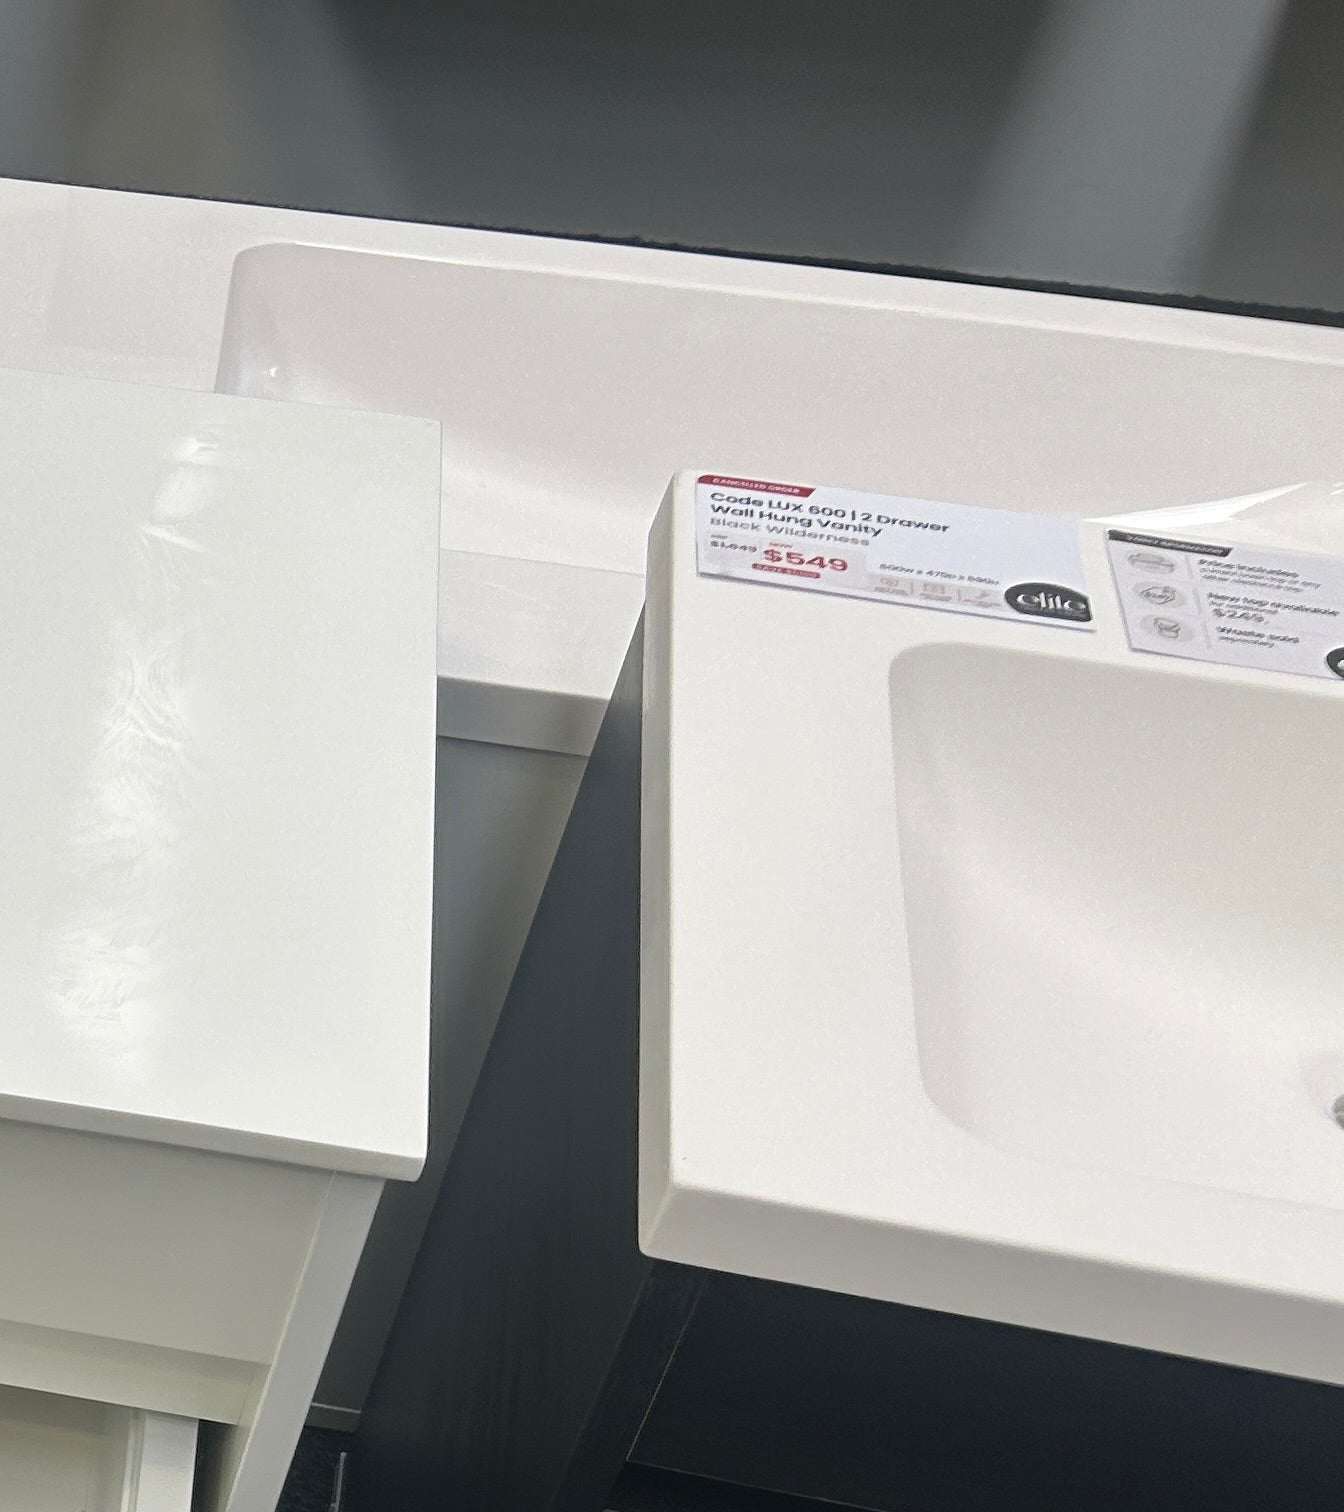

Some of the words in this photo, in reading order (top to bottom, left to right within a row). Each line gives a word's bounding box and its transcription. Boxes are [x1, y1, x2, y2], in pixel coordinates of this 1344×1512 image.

[710, 492, 764, 507] Code
[768, 500, 804, 513] LUX
[808, 505, 846, 518] 600
[861, 512, 873, 522] 2
[877, 515, 950, 533] Drawer
[710, 504, 754, 518] Wall
[759, 510, 813, 528] Hung
[816, 518, 883, 537] Vanity
[710, 517, 761, 531] Black
[765, 524, 870, 547] Wilderness
[763, 548, 849, 572] $549
[1016, 591, 1087, 610] elite
